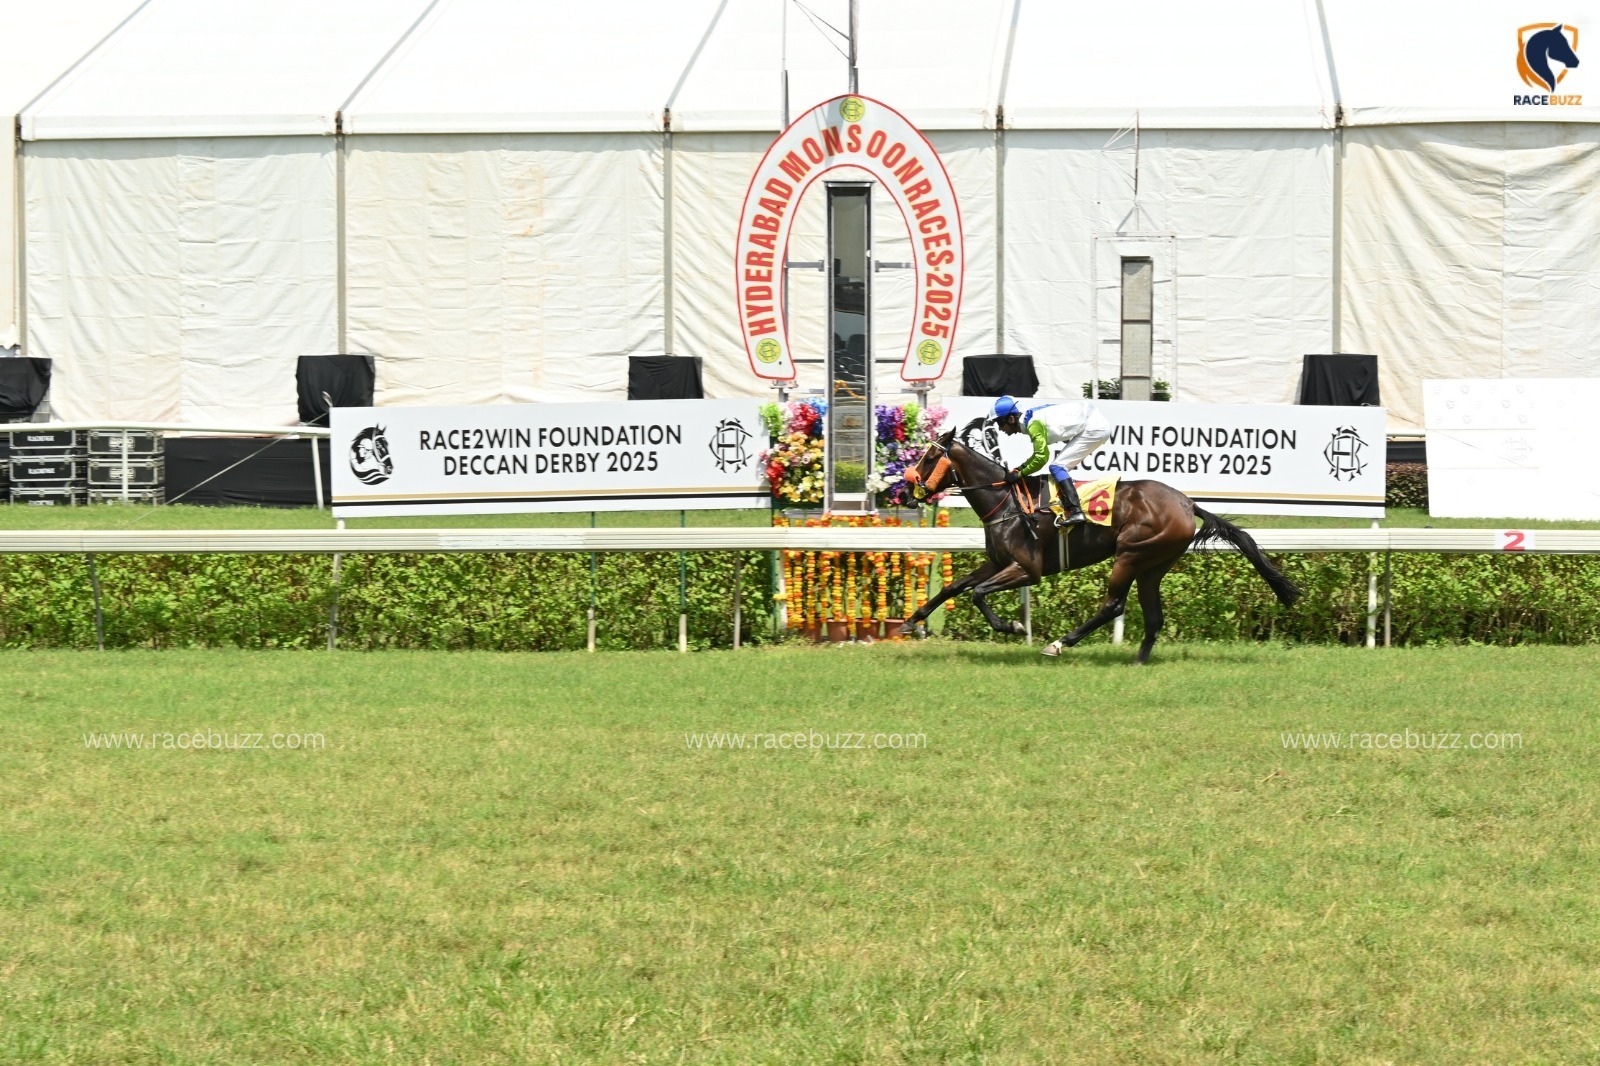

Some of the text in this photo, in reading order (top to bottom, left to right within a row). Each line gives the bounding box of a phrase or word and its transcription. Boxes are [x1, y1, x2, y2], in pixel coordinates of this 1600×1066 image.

[745, 177, 793, 337] HYDERABAD
[420, 424, 682, 450] RACE2WIN FOUNDATION
[1152, 426, 1297, 450] FOUNDATION
[444, 451, 658, 476] DECCAN DERBY 2025
[1055, 450, 1272, 475] CCAN DERBY 2025
[1088, 489, 1110, 522] 6
[1503, 531, 1525, 551] 2
